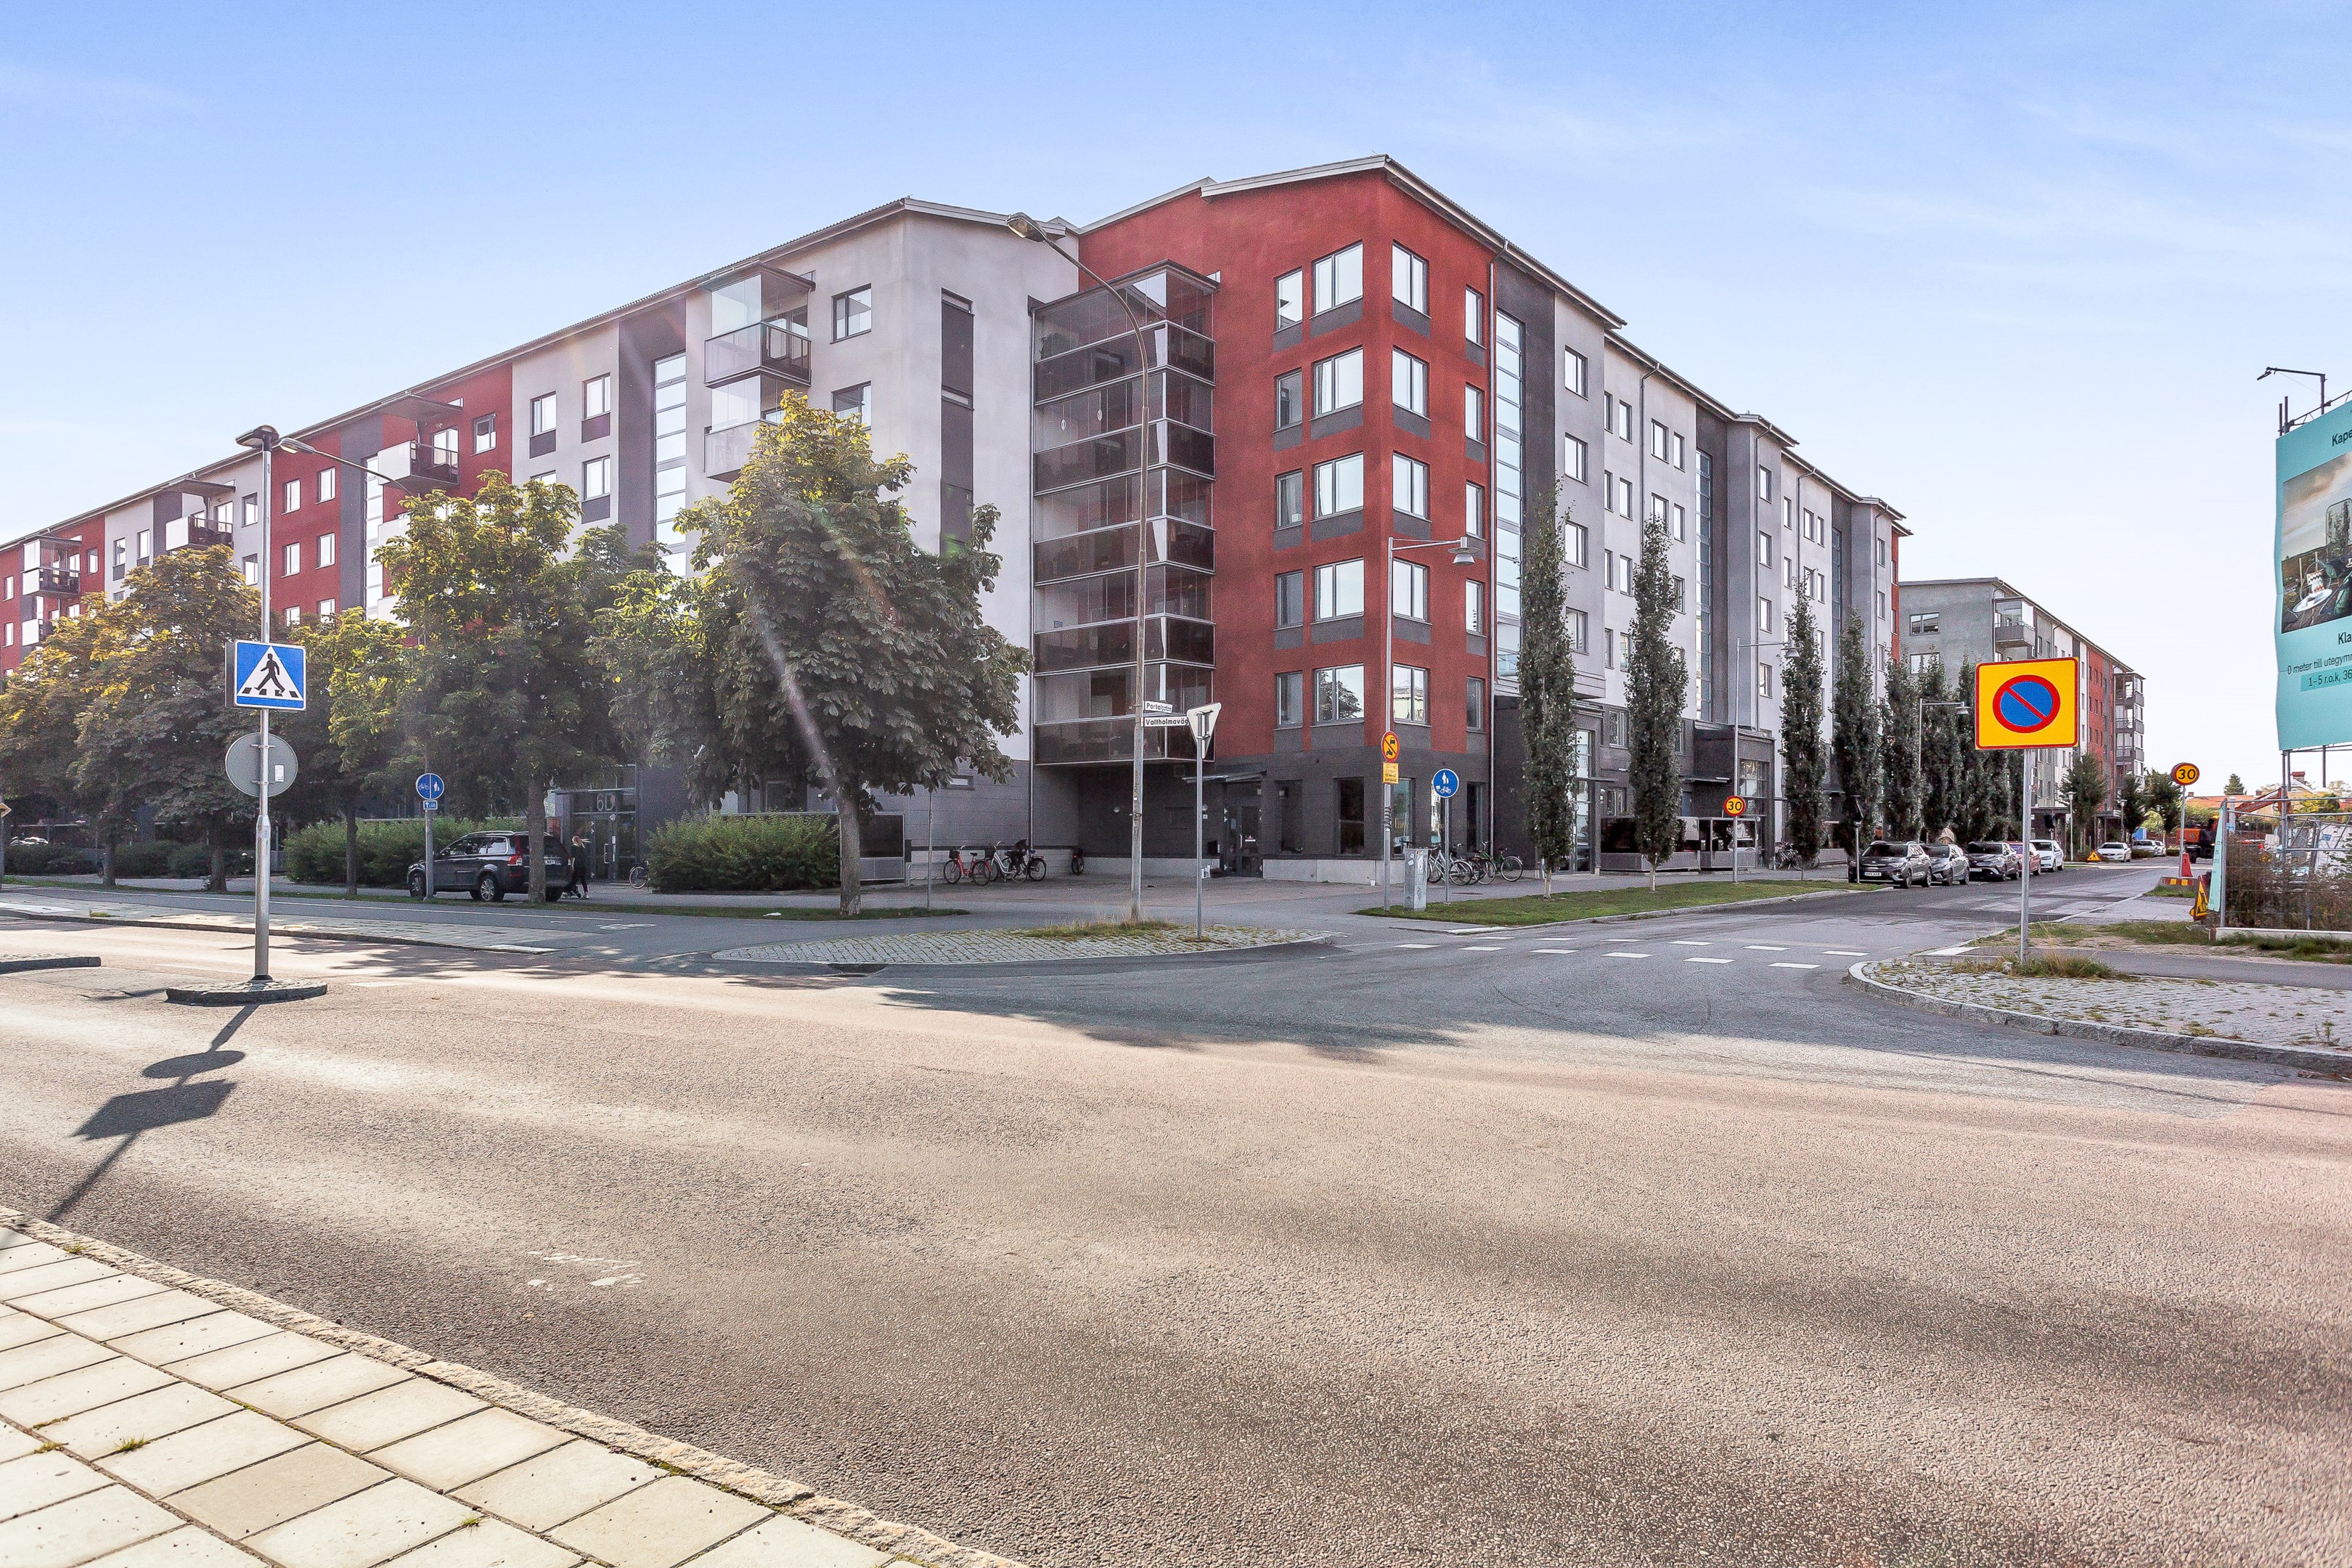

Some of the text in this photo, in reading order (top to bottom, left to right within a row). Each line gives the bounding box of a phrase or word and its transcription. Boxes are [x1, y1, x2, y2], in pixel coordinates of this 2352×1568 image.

[2293, 663, 2312, 673] meter
[2314, 658, 2322, 669] till
[2178, 769, 2196, 780] 30
[1728, 801, 1742, 811] 30
